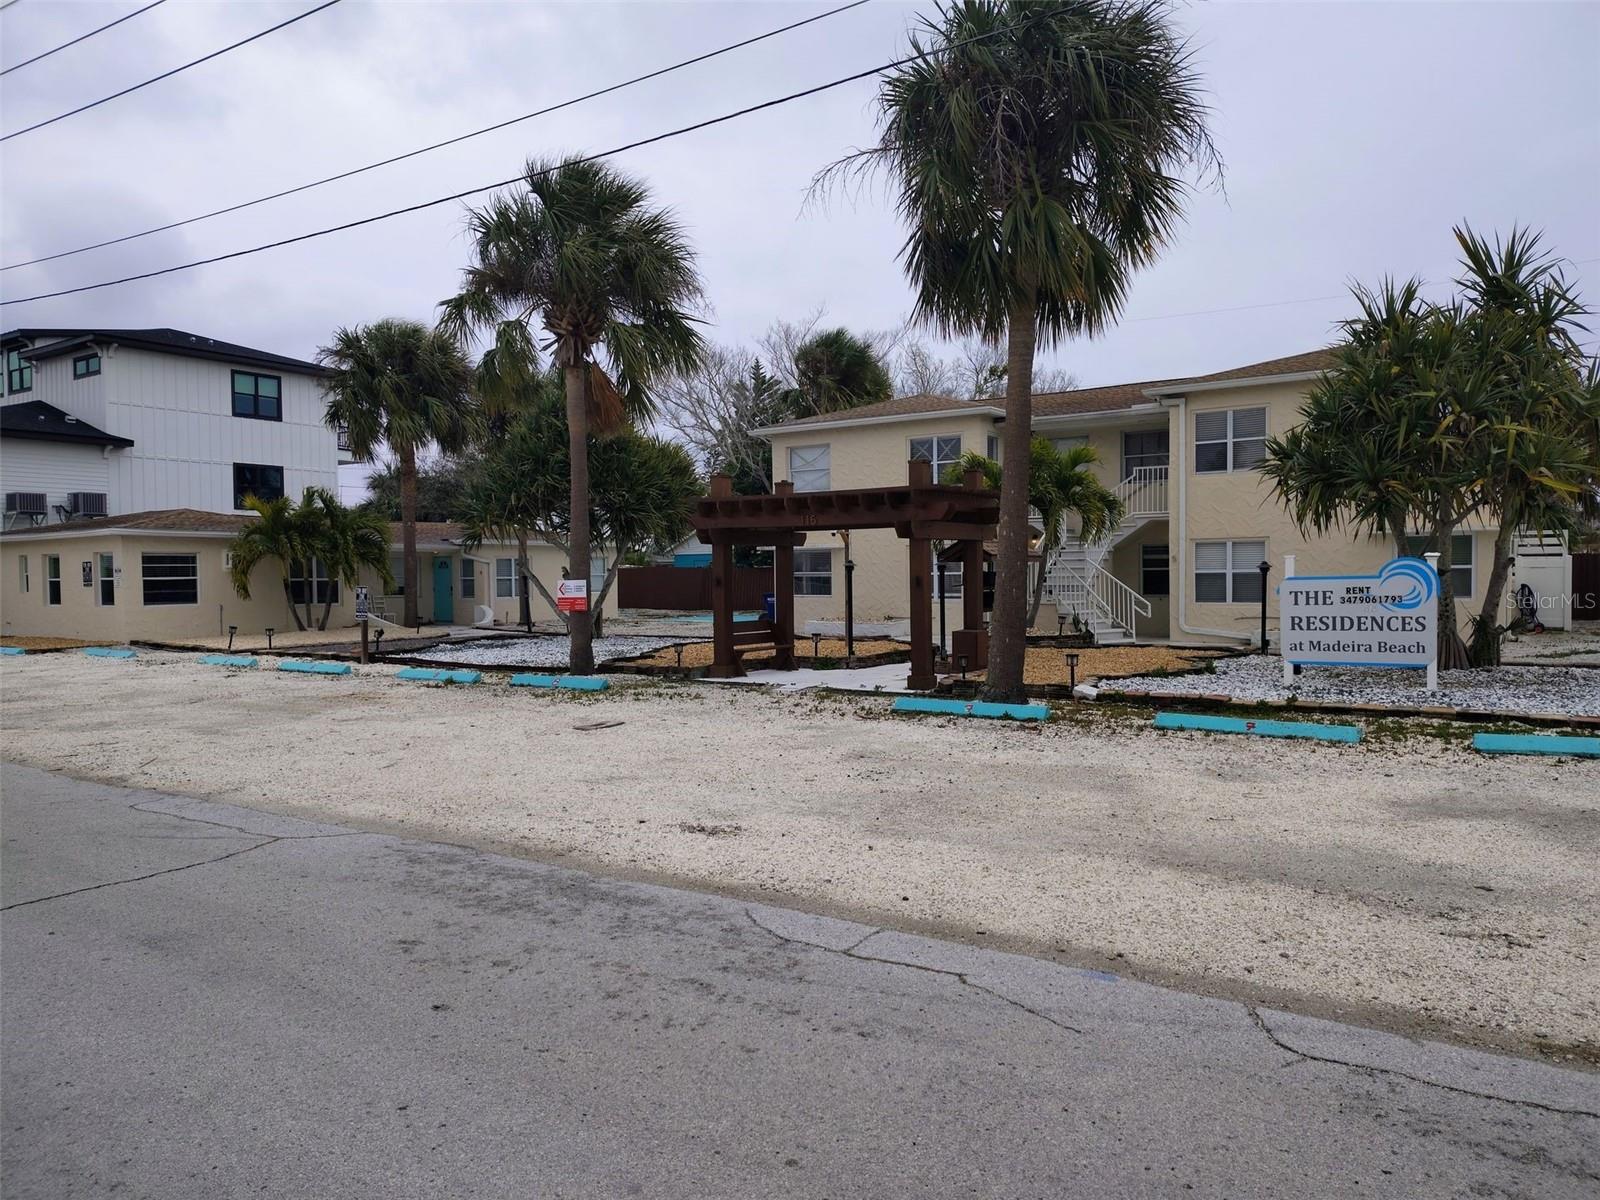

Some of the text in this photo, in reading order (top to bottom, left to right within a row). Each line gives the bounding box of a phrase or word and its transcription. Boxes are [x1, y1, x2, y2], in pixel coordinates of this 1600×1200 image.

[1345, 586, 1371, 595] RENT
[1289, 590, 1334, 606] THE
[1340, 595, 1403, 604] 3479061793
[1290, 615, 1427, 632] RESIDENCES
[1289, 640, 1426, 654] at Madeira Beach
